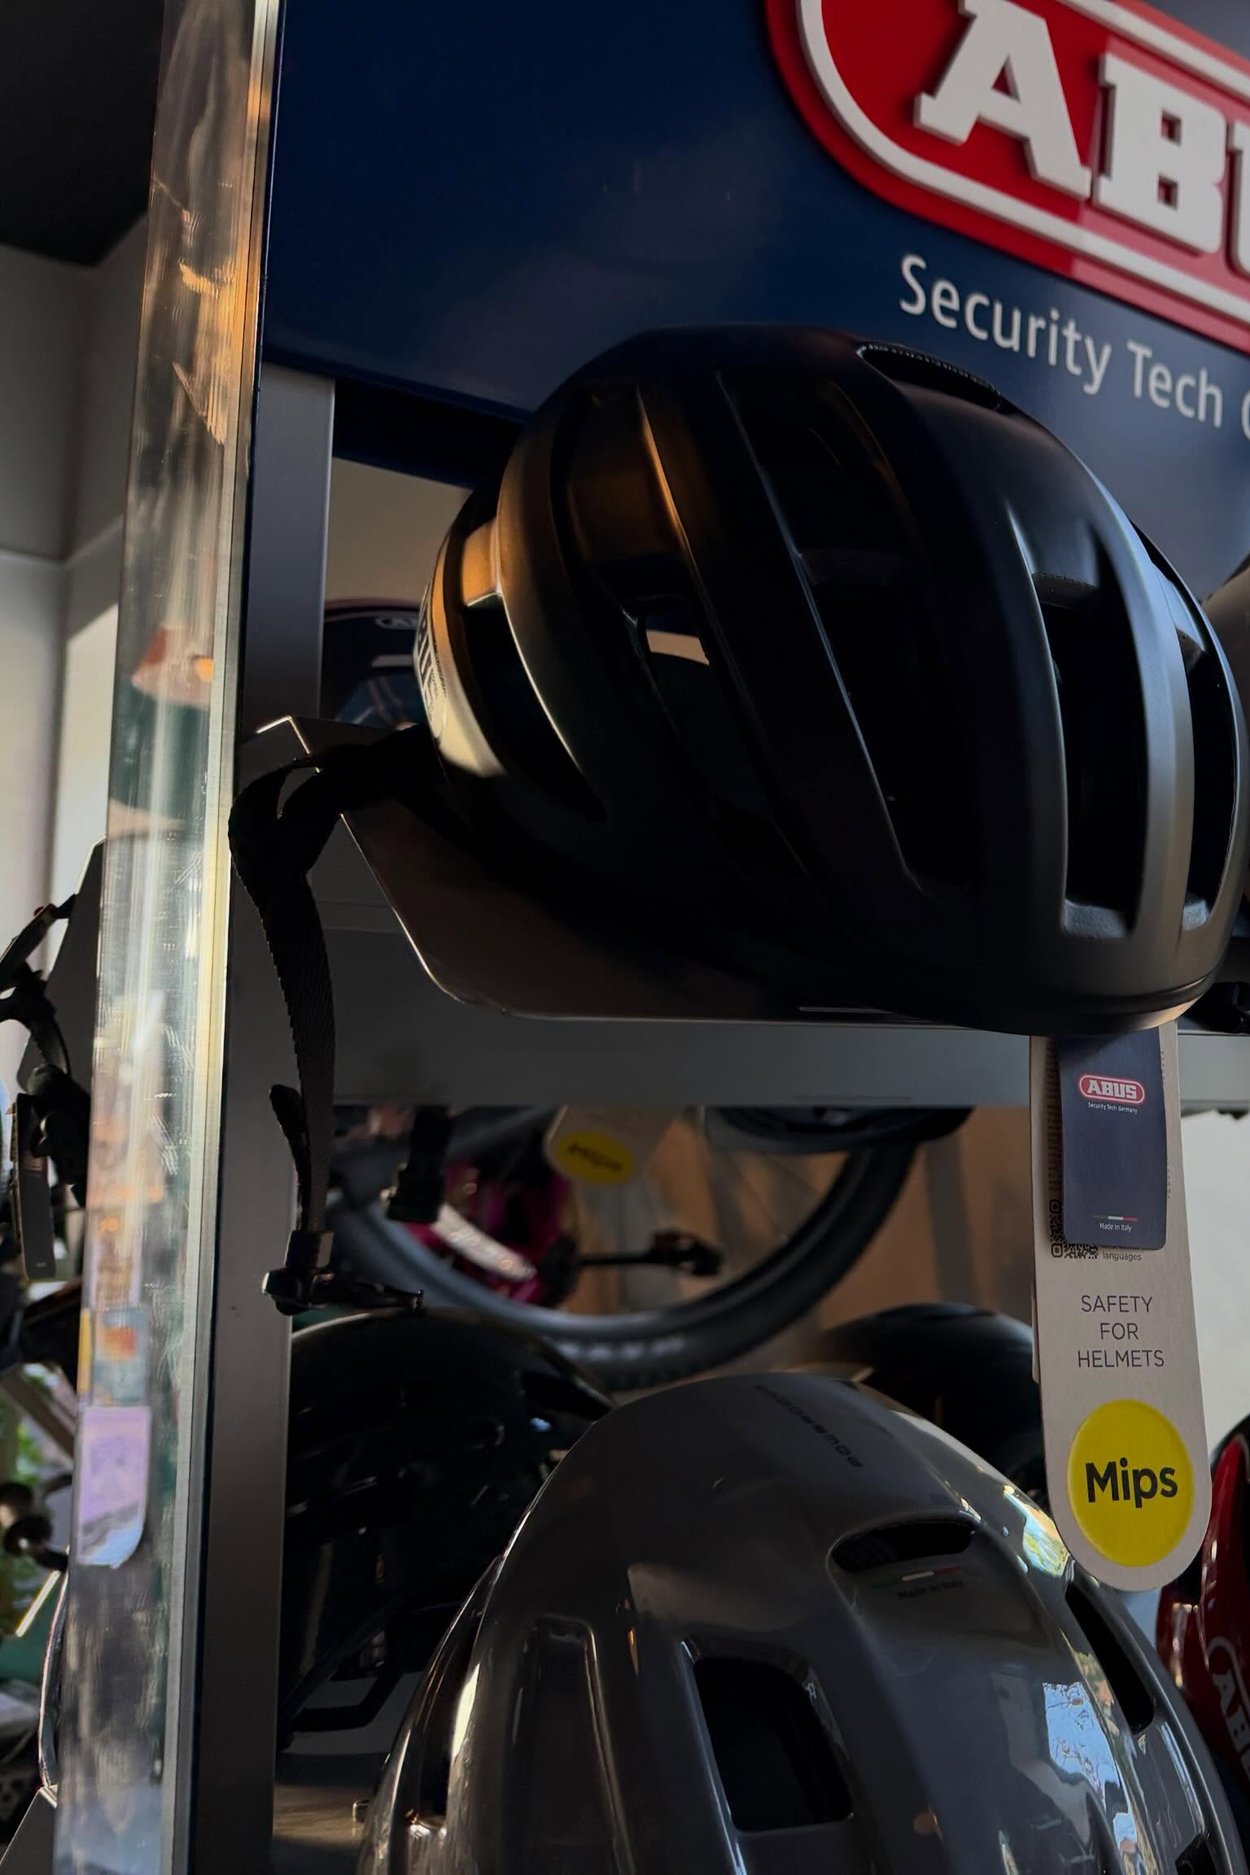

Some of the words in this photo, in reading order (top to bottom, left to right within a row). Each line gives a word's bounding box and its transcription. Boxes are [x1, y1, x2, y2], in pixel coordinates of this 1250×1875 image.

[899, 253, 1112, 396] Security
[1127, 340, 1223, 429] Tech
[1087, 1079, 1137, 1099] ABUS
[1088, 1102, 1106, 1111] Security
[1102, 1251, 1143, 1262] languages
[1081, 1295, 1153, 1313] SAFETY
[1099, 1322, 1140, 1341] FOR
[1077, 1350, 1165, 1368] HELMETS
[1085, 1457, 1179, 1509] Mips
